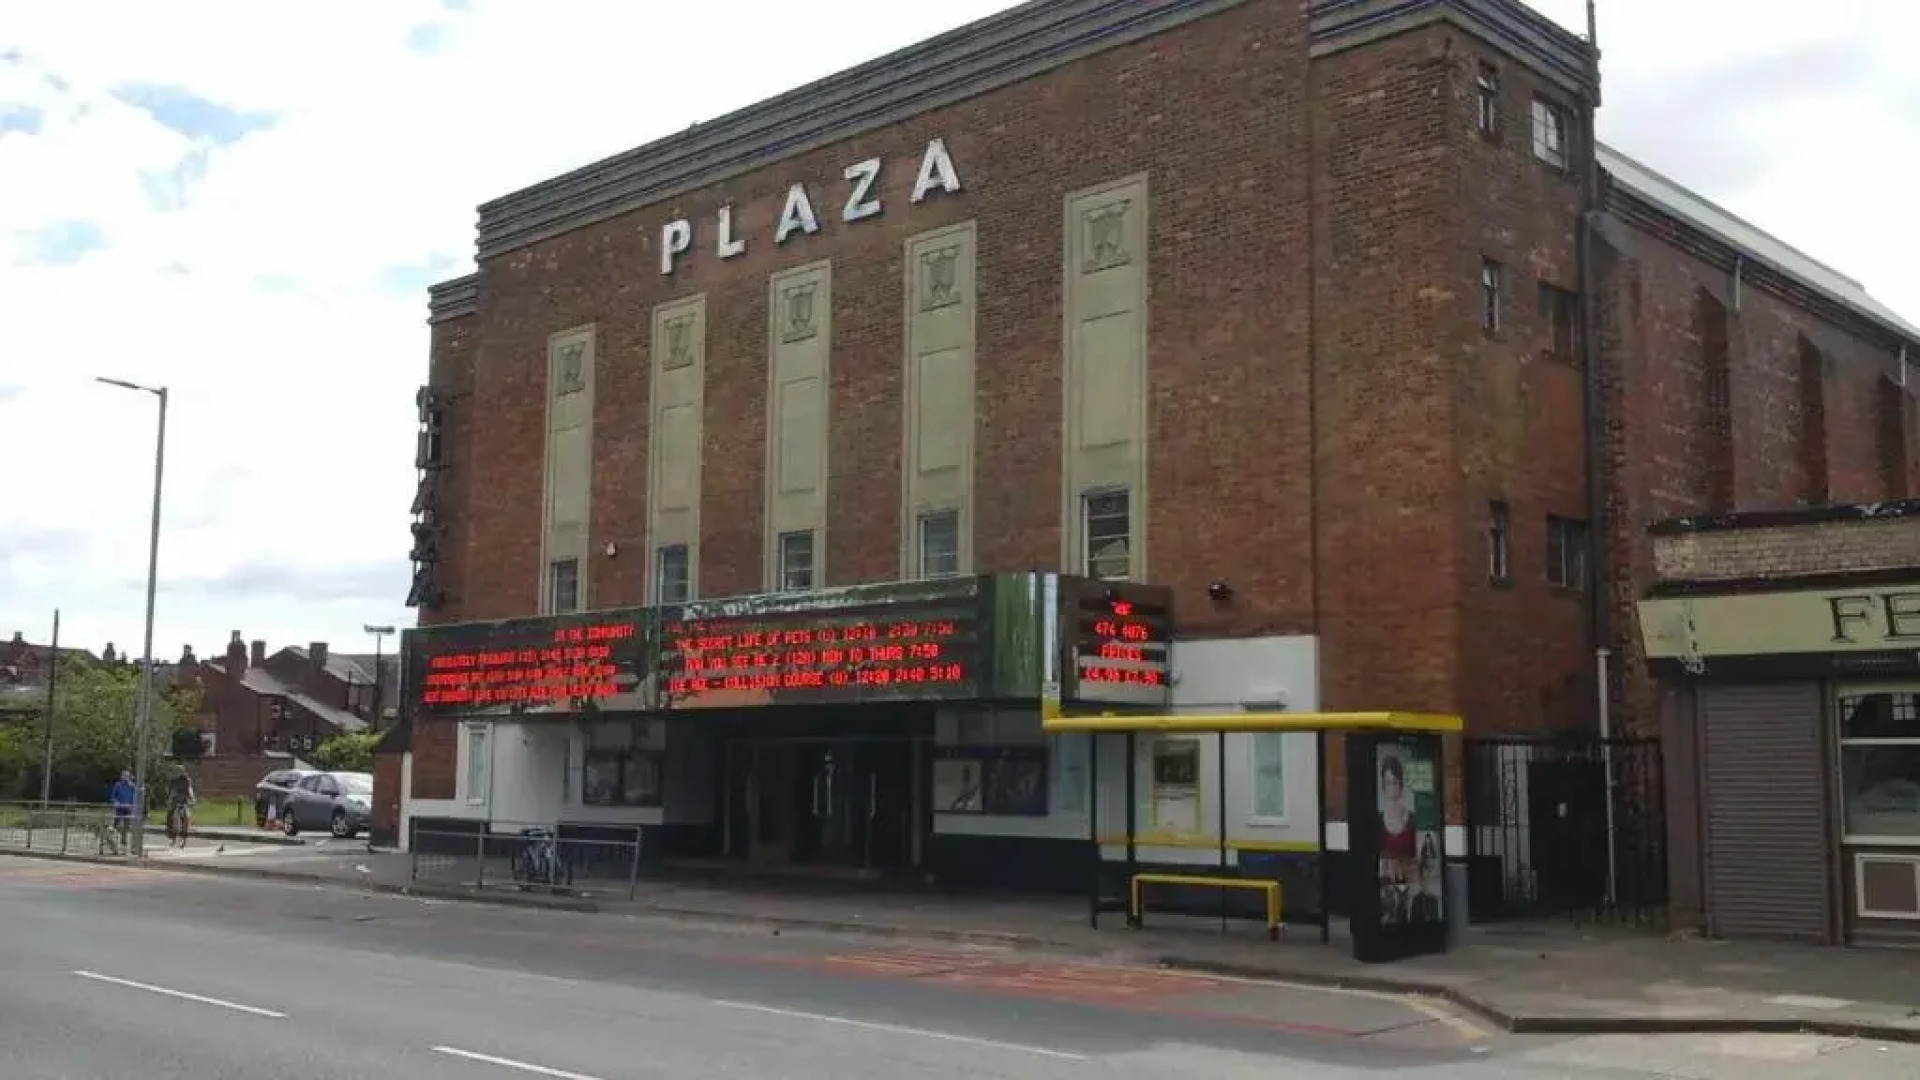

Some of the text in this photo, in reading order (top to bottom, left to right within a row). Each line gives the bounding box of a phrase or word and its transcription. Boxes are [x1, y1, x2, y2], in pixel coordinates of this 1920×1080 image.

[660, 138, 961, 276] PLAZA
[738, 632, 762, 648] LIFE
[784, 629, 811, 644] PETS
[725, 673, 780, 690] COLLISION
[783, 670, 824, 687] COURSE
